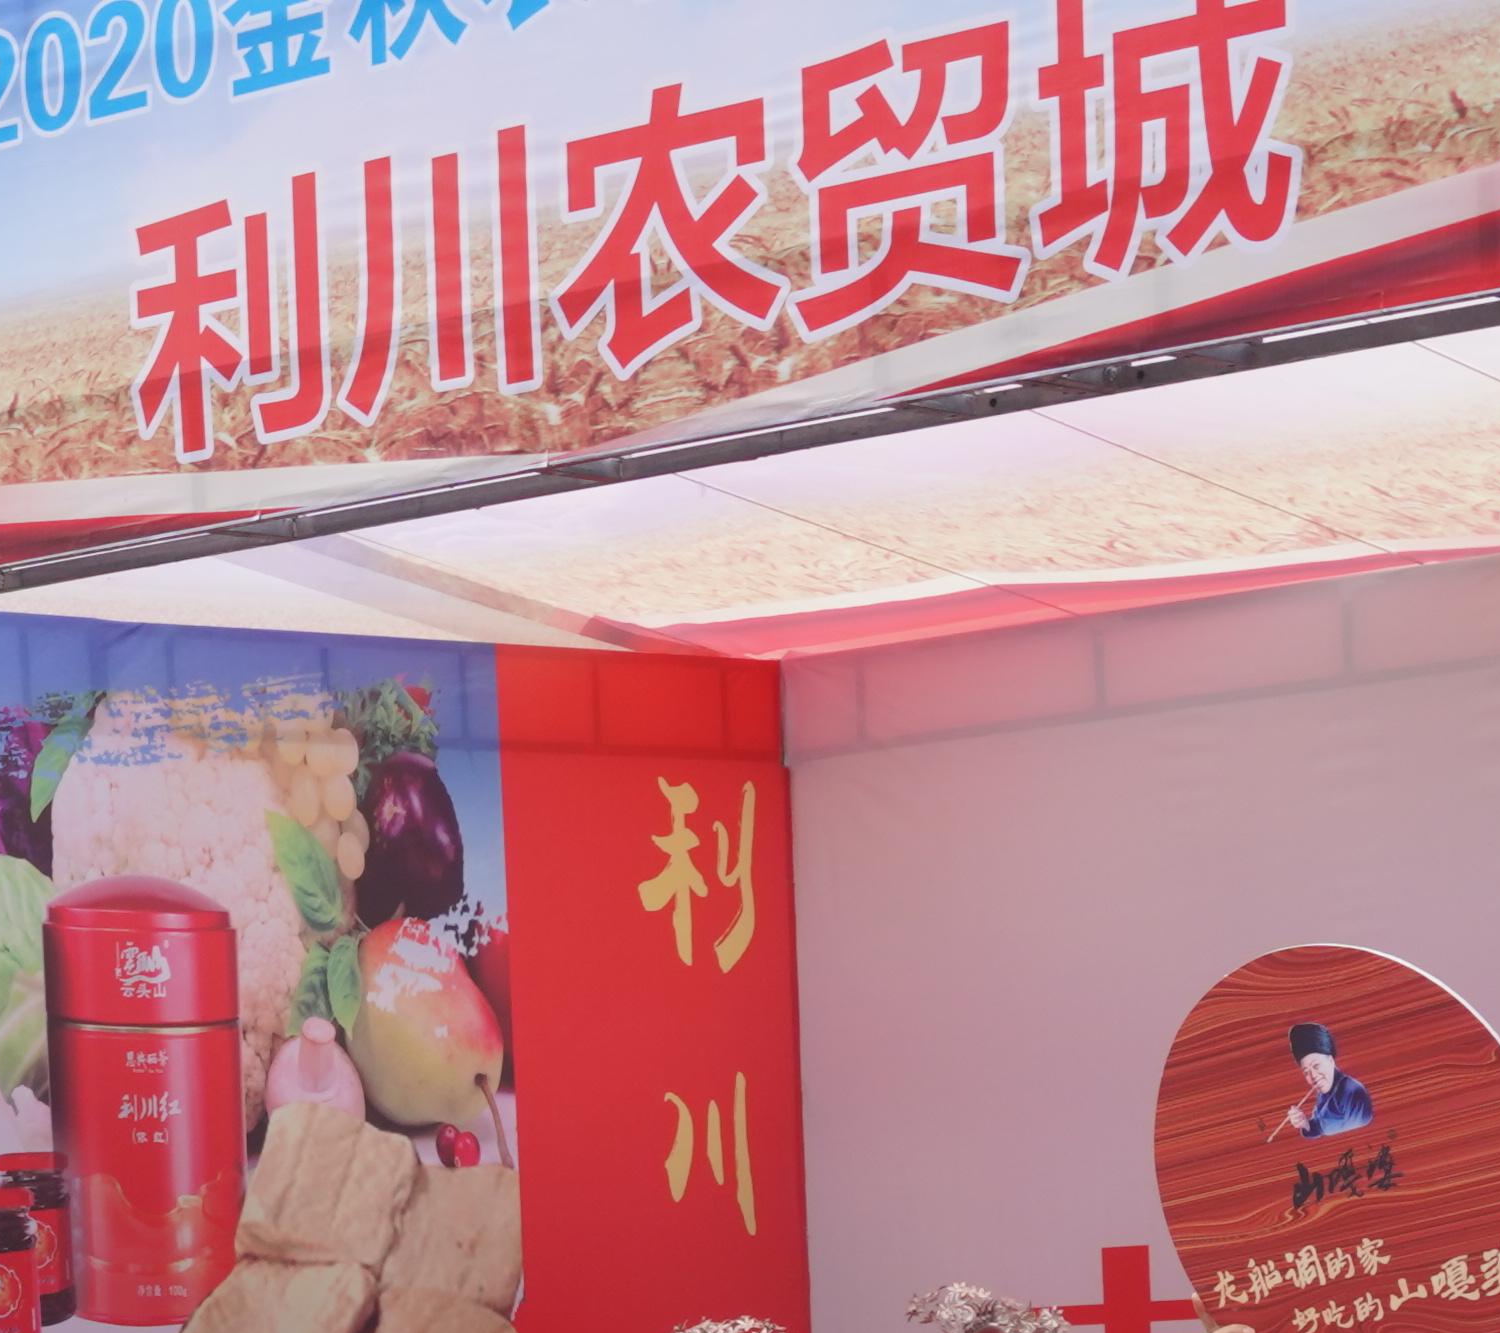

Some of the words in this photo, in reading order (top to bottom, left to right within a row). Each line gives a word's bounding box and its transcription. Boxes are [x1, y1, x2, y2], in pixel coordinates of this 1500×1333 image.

[134, 0, 1296, 456] 利川农贸城
[638, 776, 757, 1236] 利川
[1213, 1238, 1392, 1309] 龙船调的家
